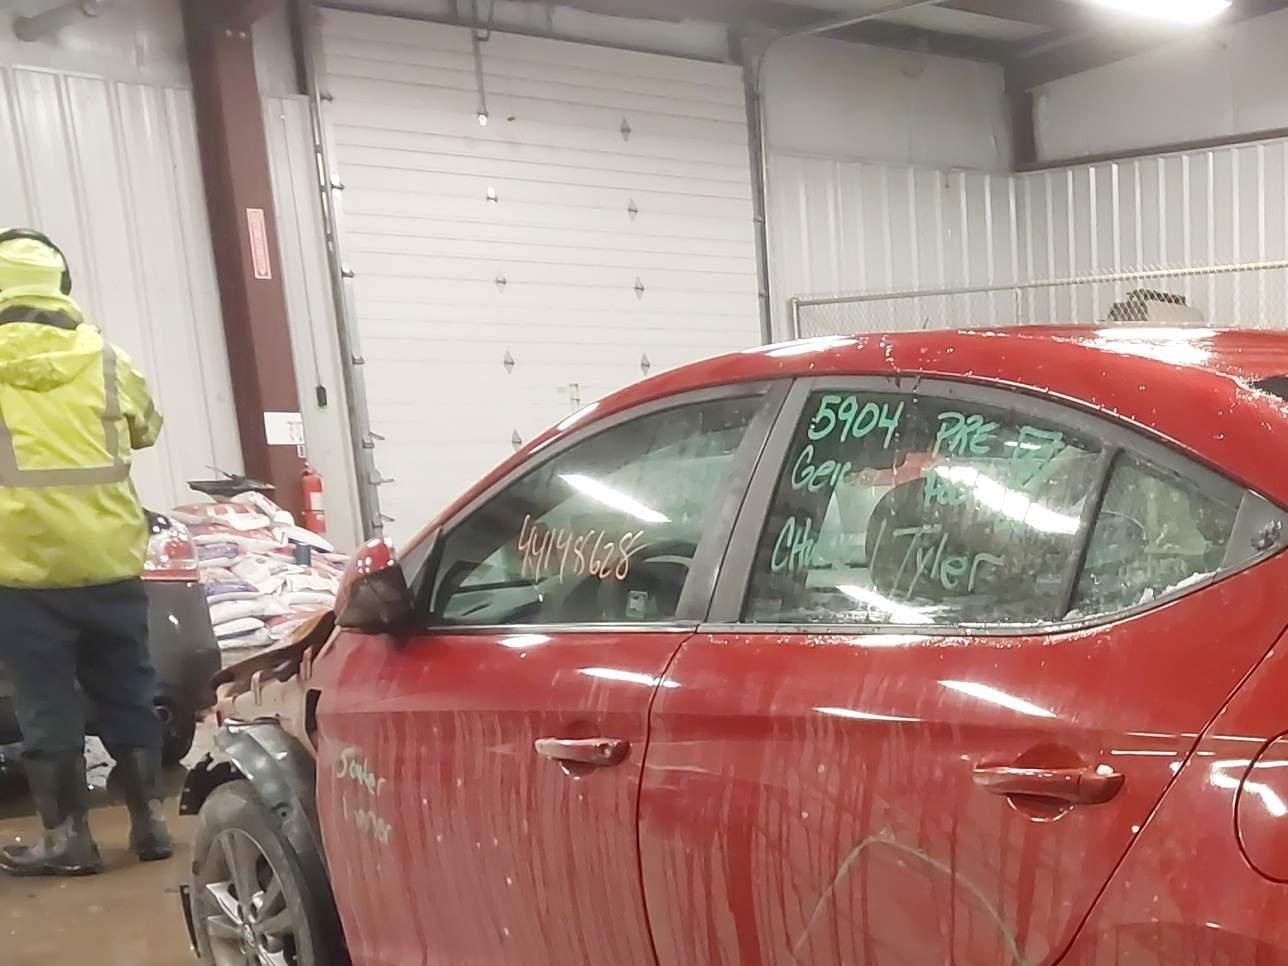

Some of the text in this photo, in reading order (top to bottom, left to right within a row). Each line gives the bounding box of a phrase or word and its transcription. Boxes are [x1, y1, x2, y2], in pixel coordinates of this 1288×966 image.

[807, 394, 904, 449] 5904
[518, 514, 650, 584] 44148628
[888, 524, 1004, 600] Tyler
